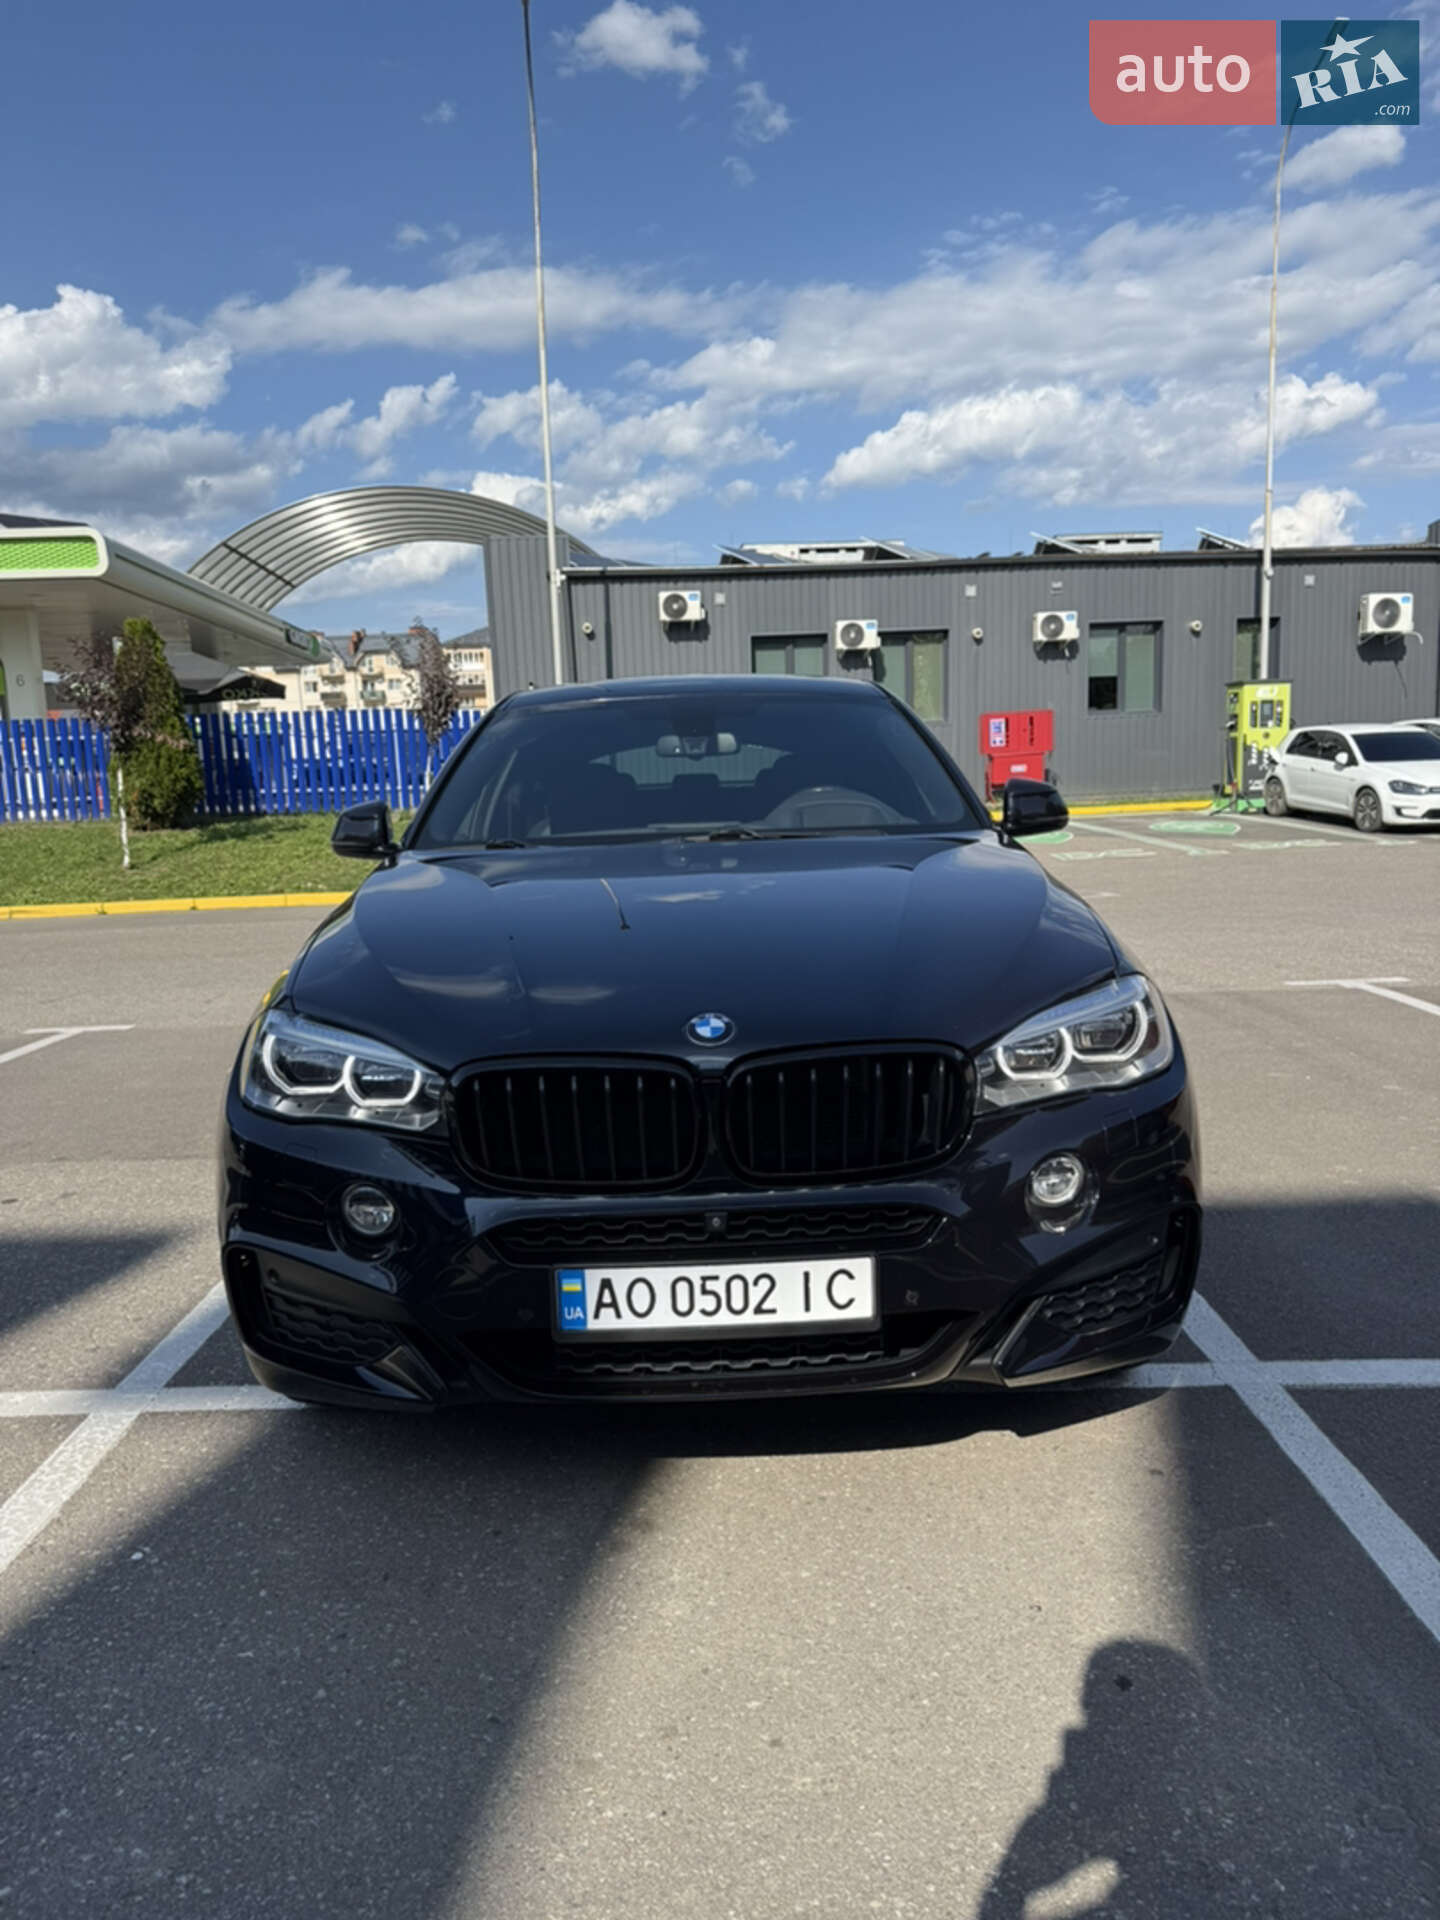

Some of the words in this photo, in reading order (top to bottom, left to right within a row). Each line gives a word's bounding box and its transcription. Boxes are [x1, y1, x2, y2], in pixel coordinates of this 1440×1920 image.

[16, 673, 25, 687] 6
[593, 1278, 656, 1320] AO
[671, 1274, 777, 1317] 0502
[803, 1269, 855, 1312] IC
[564, 1306, 585, 1320] UA
